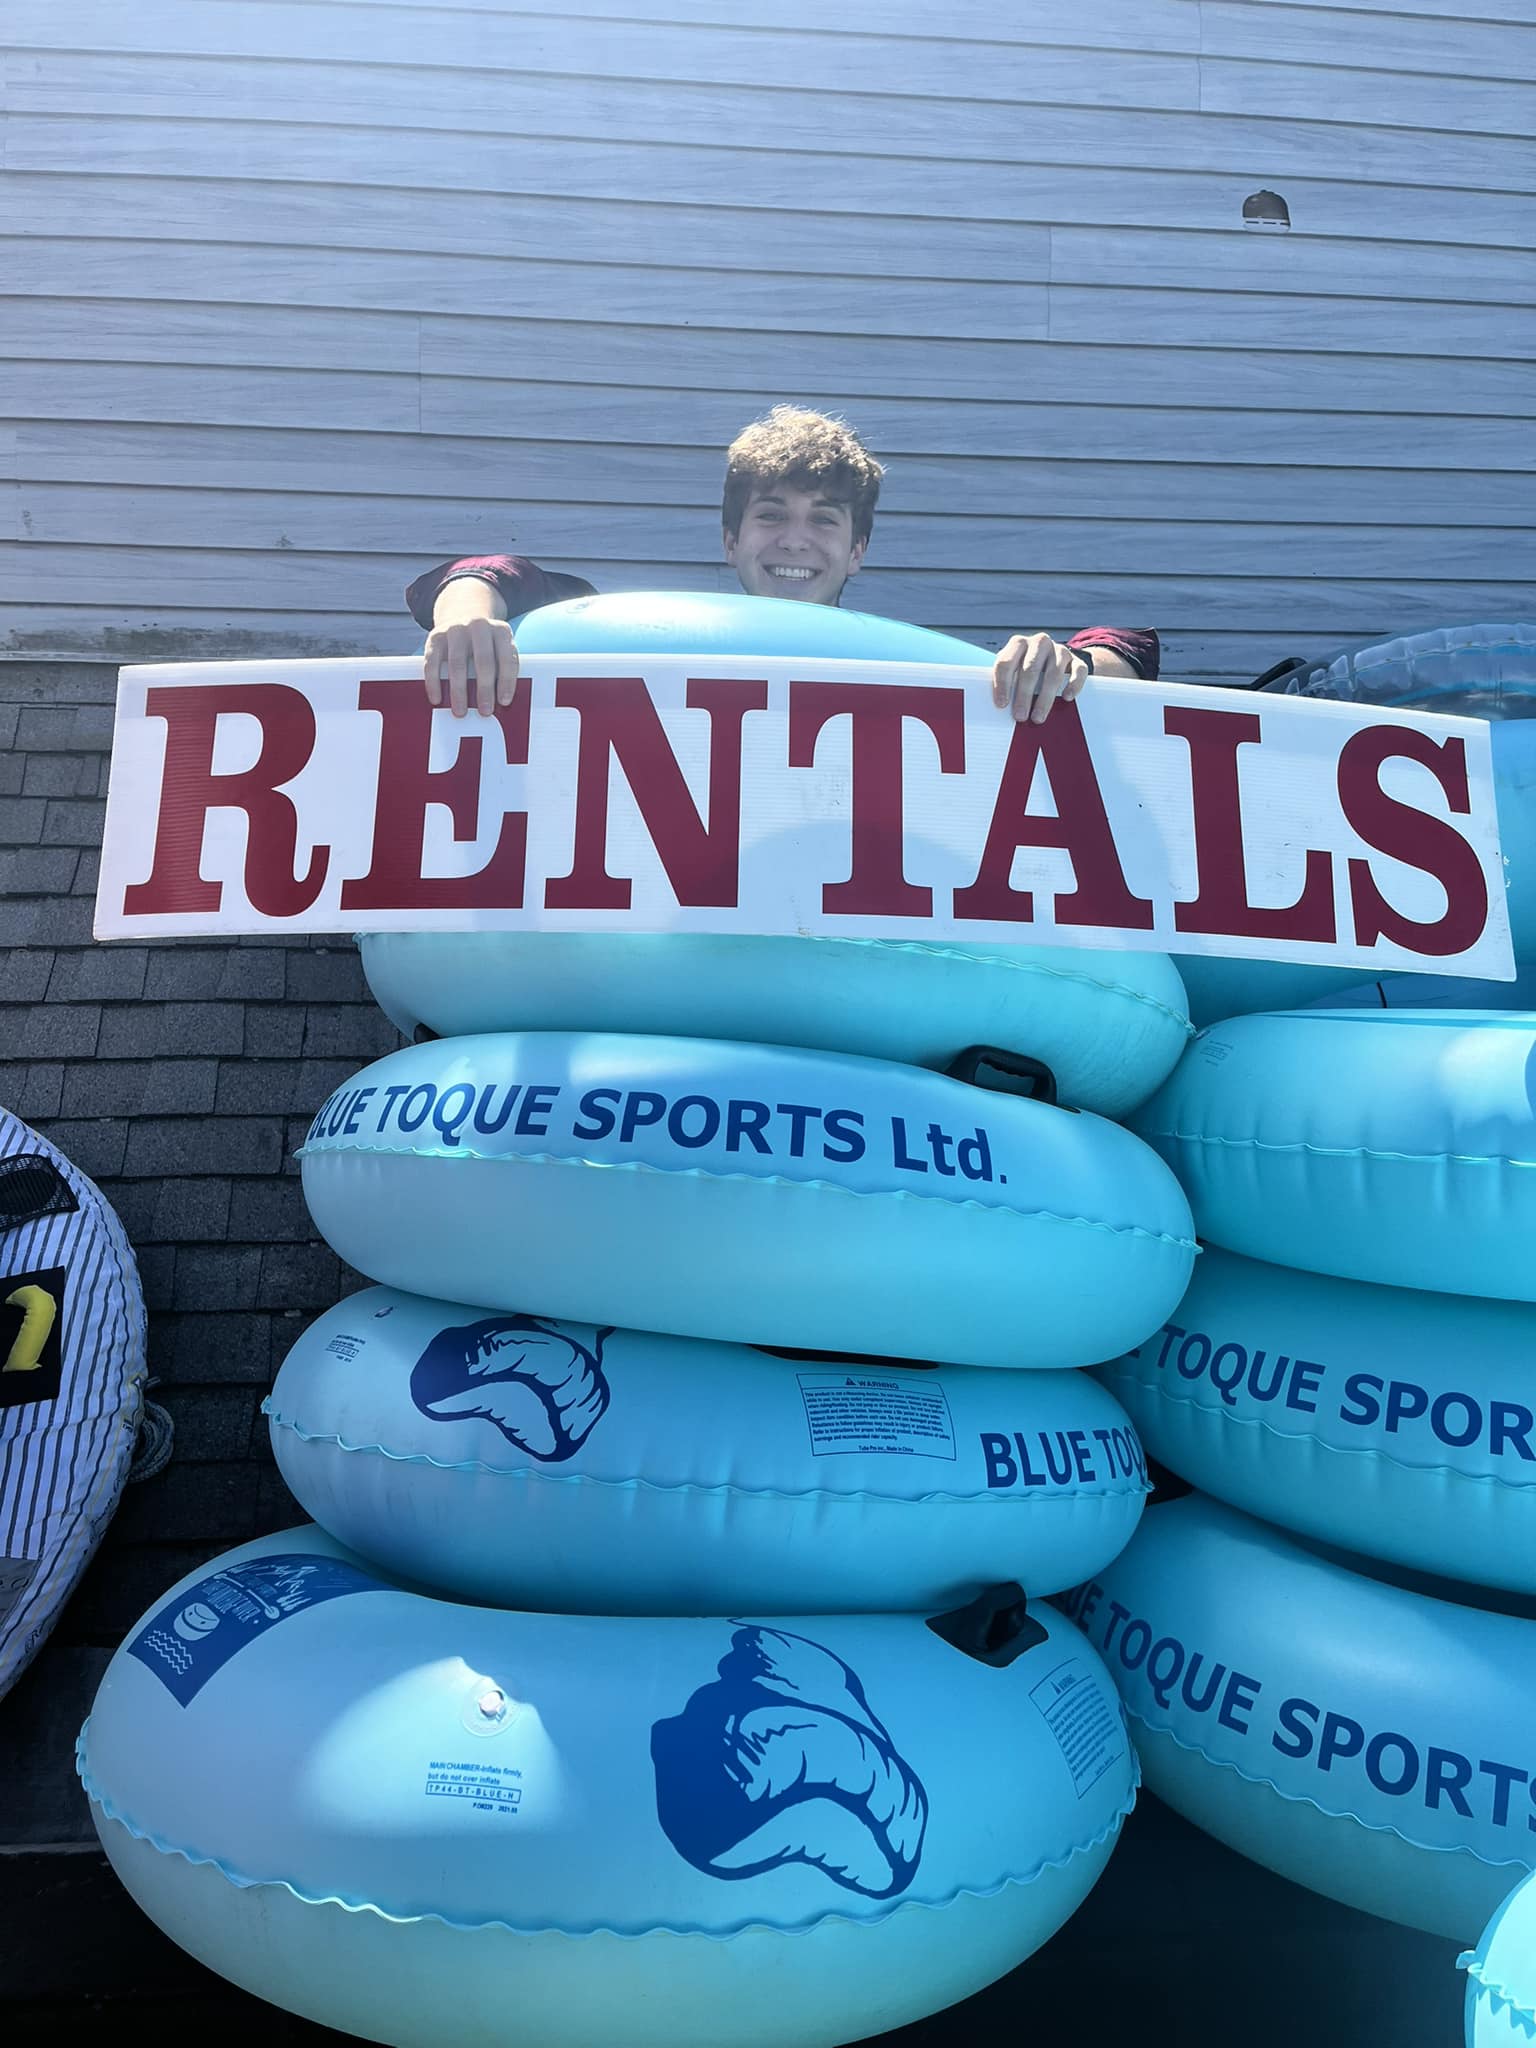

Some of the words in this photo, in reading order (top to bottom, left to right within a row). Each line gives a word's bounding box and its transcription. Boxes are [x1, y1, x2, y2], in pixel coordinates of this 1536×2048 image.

[122, 676, 1489, 958] RENTALS
[376, 1082, 560, 1147] TOQUE
[572, 1087, 867, 1164] SPORTS
[890, 1116, 1008, 1185] Ltd.
[1157, 1323, 1326, 1414] TOQUE
[1339, 1373, 1536, 1462] SPOR
[979, 1430, 1096, 1489] BLUE
[1103, 1600, 1263, 1736] TOQUE
[479, 1776, 500, 1785] inflate
